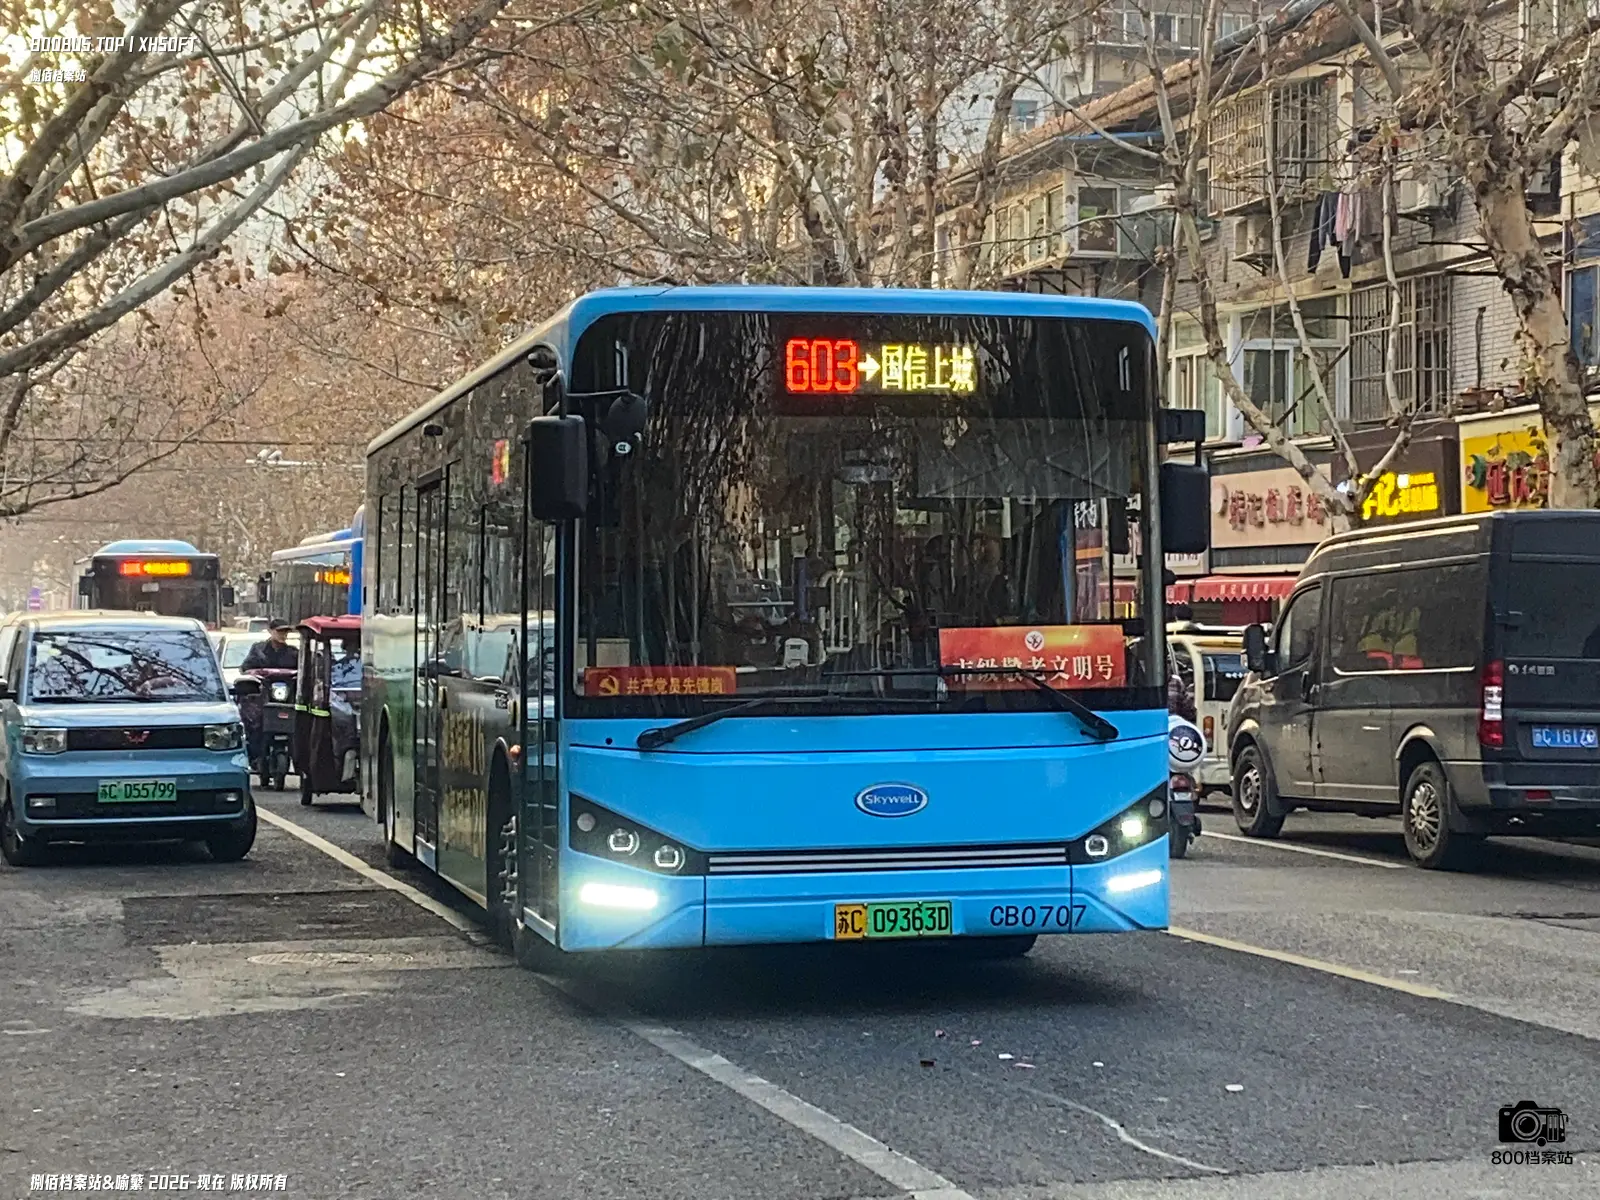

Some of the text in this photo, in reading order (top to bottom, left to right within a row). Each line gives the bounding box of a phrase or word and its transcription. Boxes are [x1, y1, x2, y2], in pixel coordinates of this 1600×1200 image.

[786, 338, 975, 393] 603 国信上城
[627, 677, 724, 695] 共产党员先锋岗
[124, 781, 175, 799] D55799
[865, 793, 920, 805] Skywell
[837, 905, 950, 935] 苏C 09363D
[989, 904, 1088, 928] CB0707
